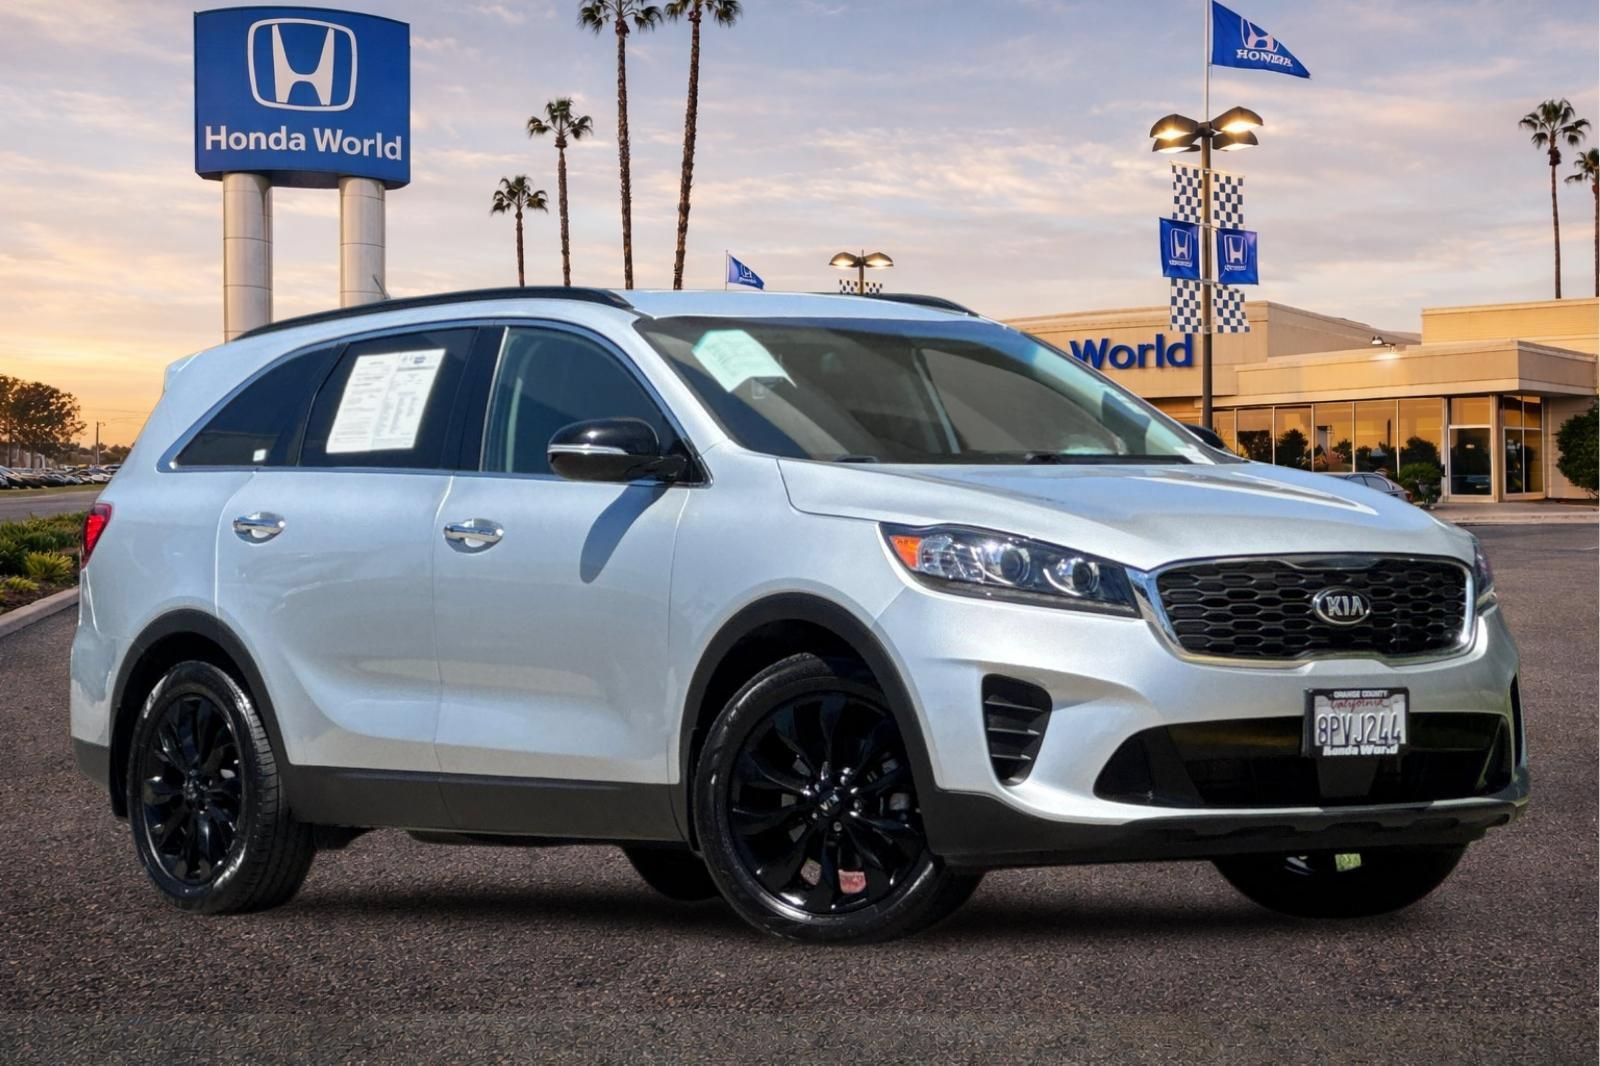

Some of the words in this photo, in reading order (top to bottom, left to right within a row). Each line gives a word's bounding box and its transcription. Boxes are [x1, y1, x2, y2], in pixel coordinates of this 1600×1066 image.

[1236, 49, 1293, 67] HONDA
[205, 125, 306, 151] Honda
[313, 127, 402, 160] World
[1069, 333, 1193, 370] World
[1326, 595, 1364, 616] KIA
[1318, 714, 1401, 746] 8PVJ244
